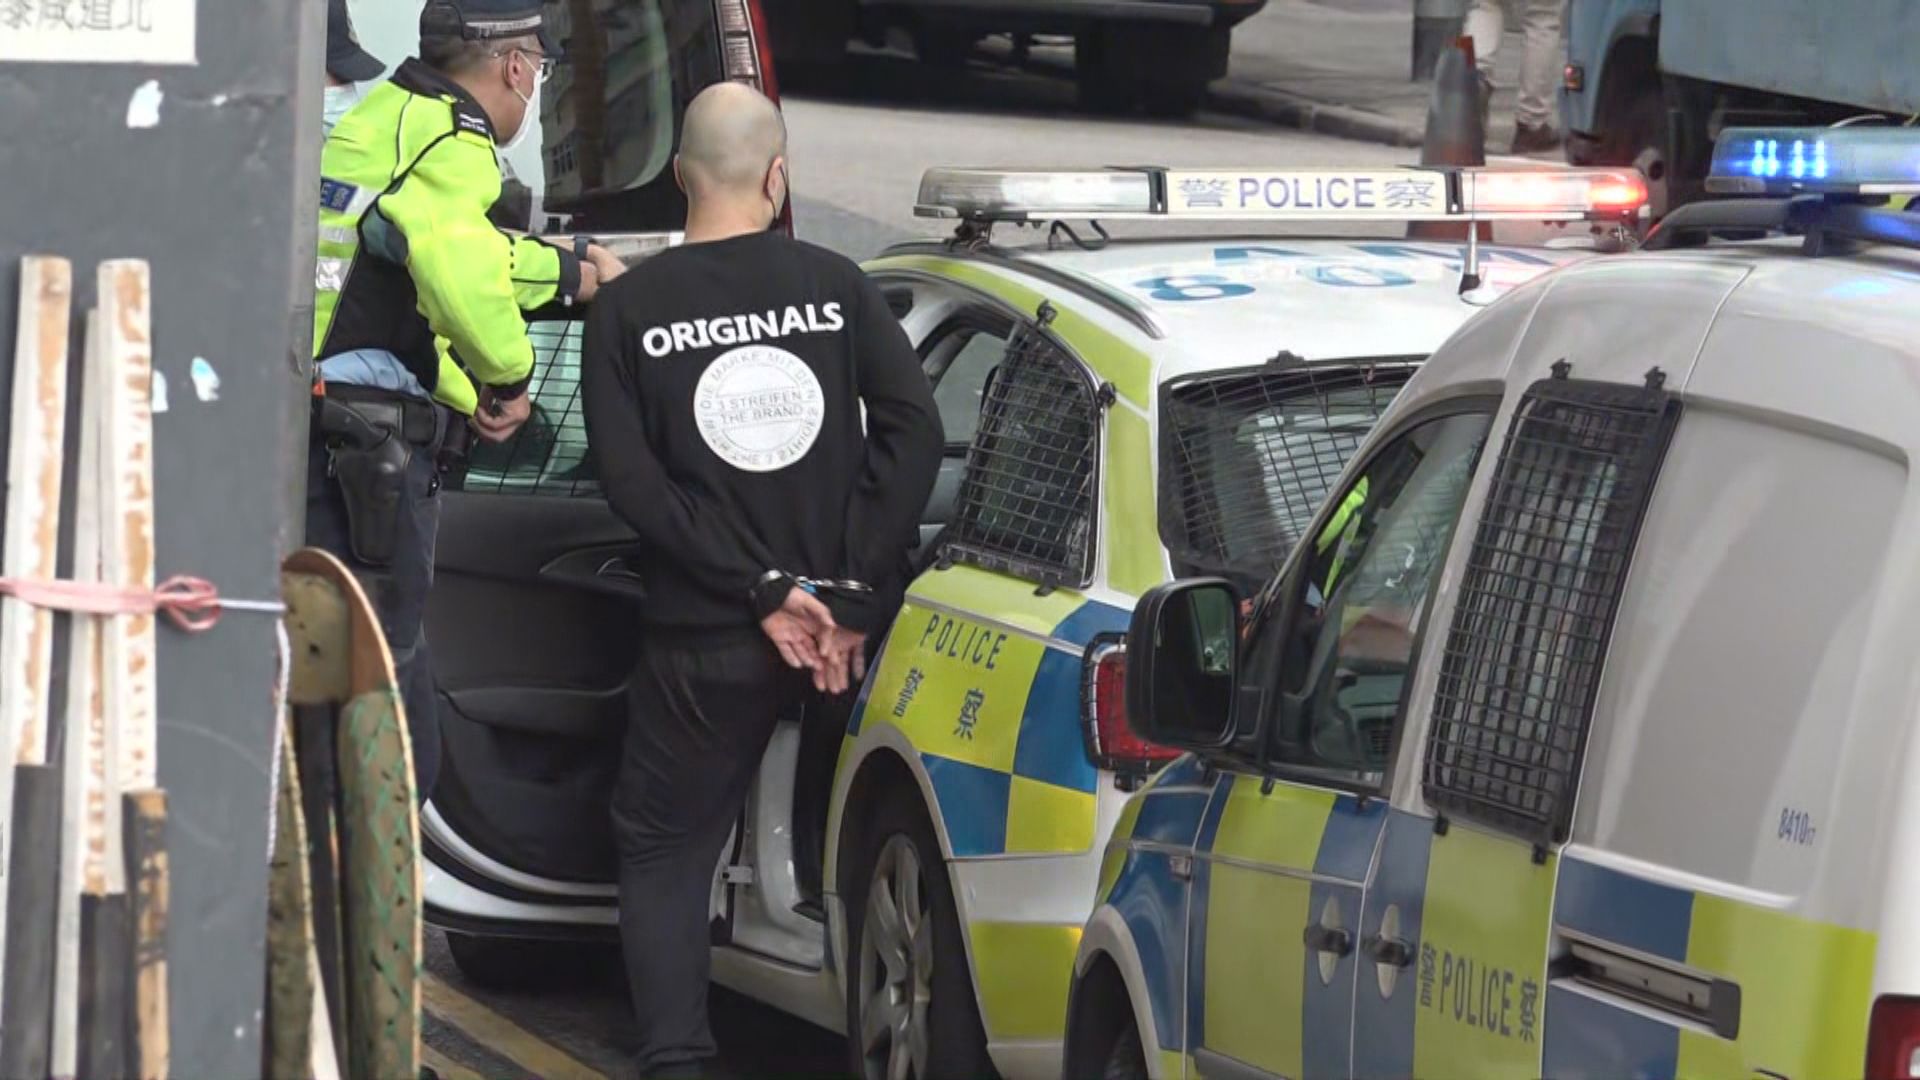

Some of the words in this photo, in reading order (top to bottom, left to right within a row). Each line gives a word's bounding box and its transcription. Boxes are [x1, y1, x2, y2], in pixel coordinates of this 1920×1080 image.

[1177, 178, 1231, 207] 警
[1239, 177, 1376, 208] POLICE
[1384, 178, 1435, 207] 察
[642, 301, 845, 358] ORIGINALS
[919, 613, 1007, 671] POLICE
[1439, 949, 1515, 1037] POLICE
